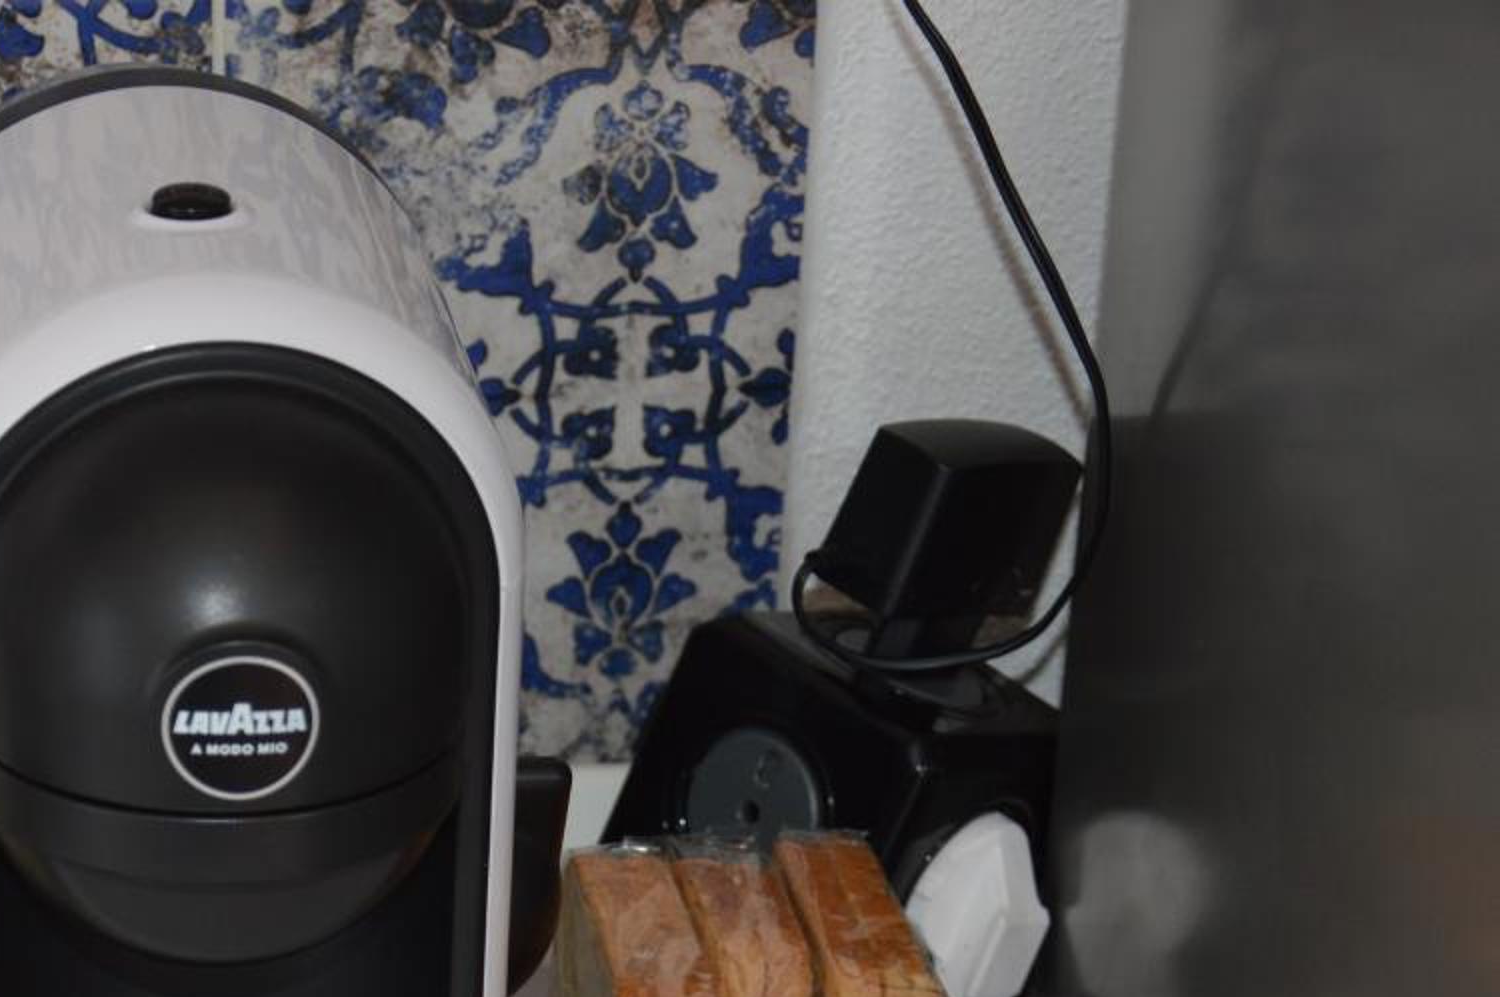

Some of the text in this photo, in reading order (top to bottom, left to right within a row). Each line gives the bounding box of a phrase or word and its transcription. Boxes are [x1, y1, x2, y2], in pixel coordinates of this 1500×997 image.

[173, 702, 307, 735] LAVAZZA
[190, 741, 288, 756] A MODO MIO
